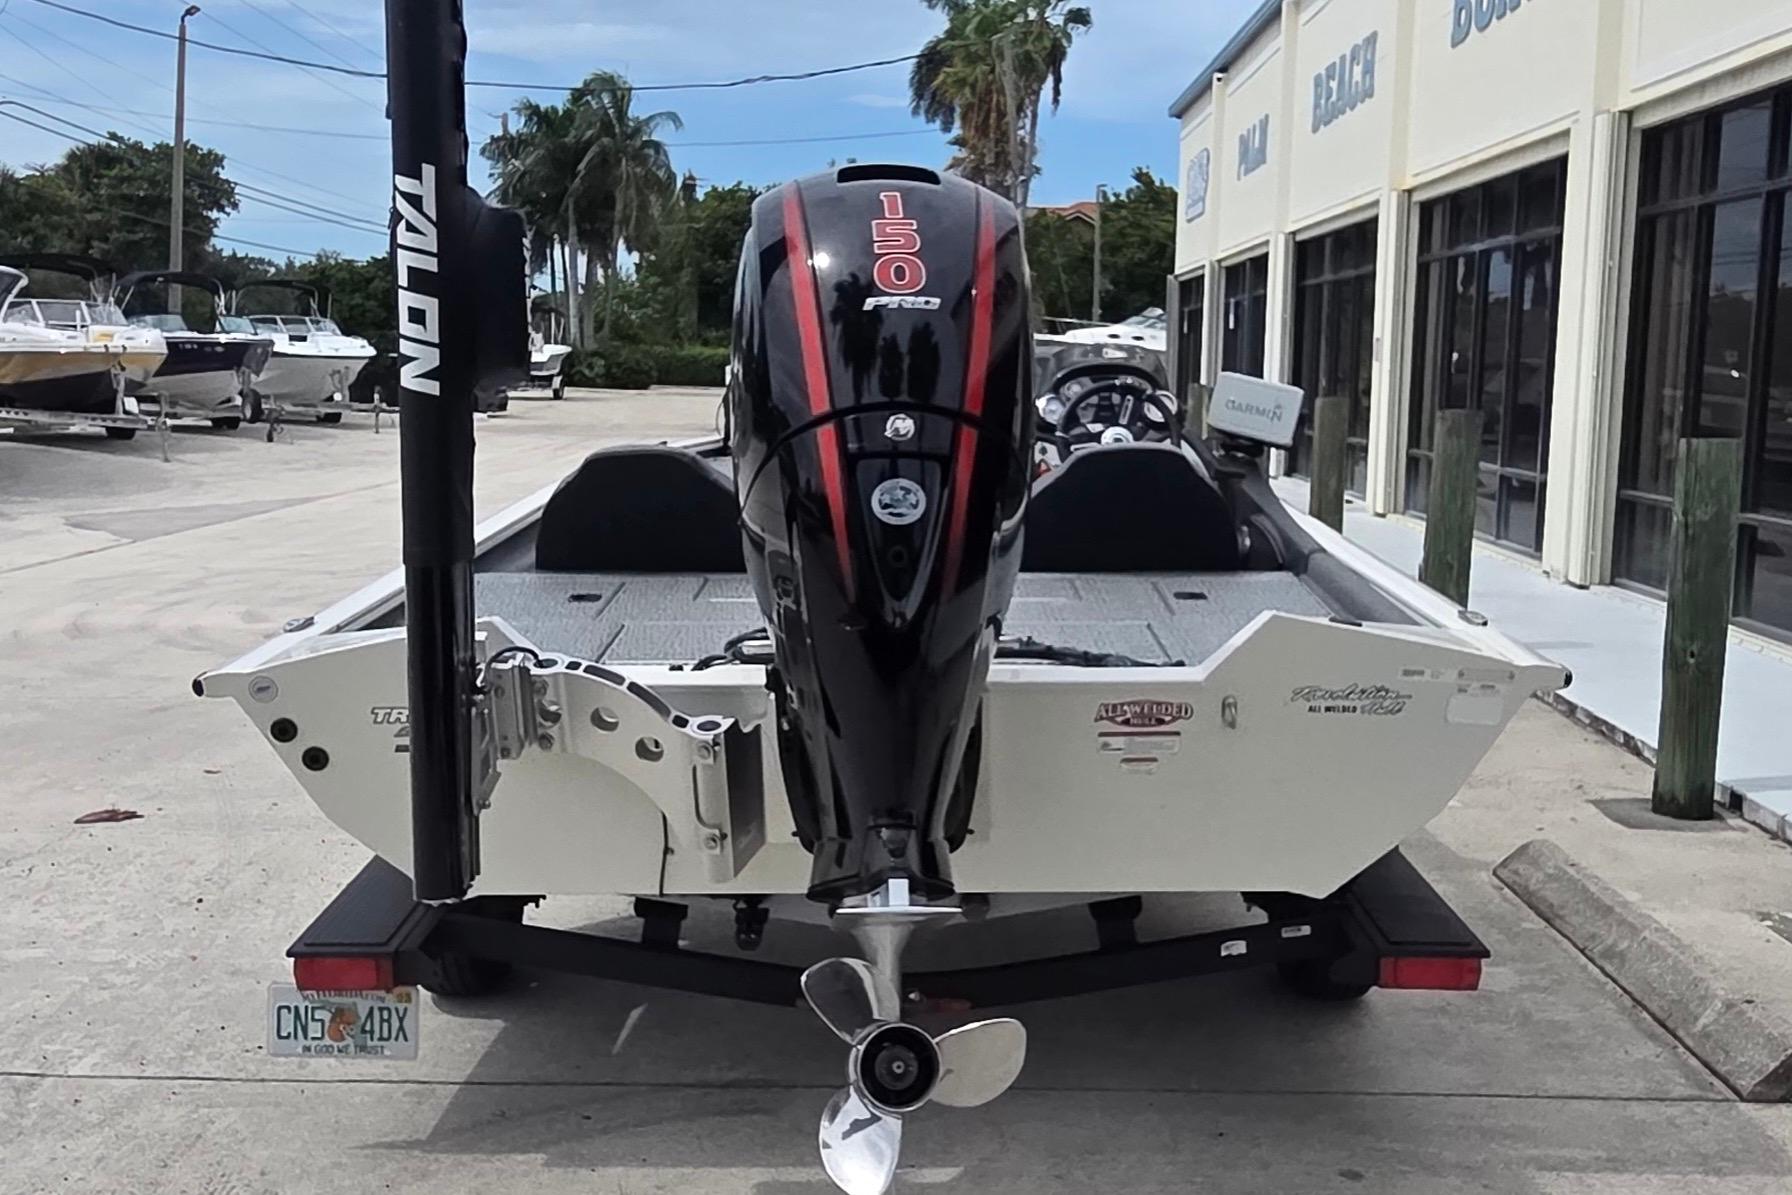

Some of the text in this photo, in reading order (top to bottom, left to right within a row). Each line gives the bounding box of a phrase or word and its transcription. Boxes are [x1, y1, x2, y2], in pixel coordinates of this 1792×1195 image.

[1312, 30, 1378, 134] BEACH
[1237, 113, 1269, 181] PALM
[871, 191, 926, 294] 150
[395, 162, 441, 397] TALON
[1225, 399, 1283, 423] GARMIN
[371, 706, 409, 724] TR
[1094, 702, 1194, 722] ALL WELDED
[1308, 705, 1321, 713] ALL
[1324, 705, 1358, 713] WELDED
[276, 1004, 409, 1042] CN5 4BX
[302, 1045, 385, 1055] IN GOD WE TRUST
